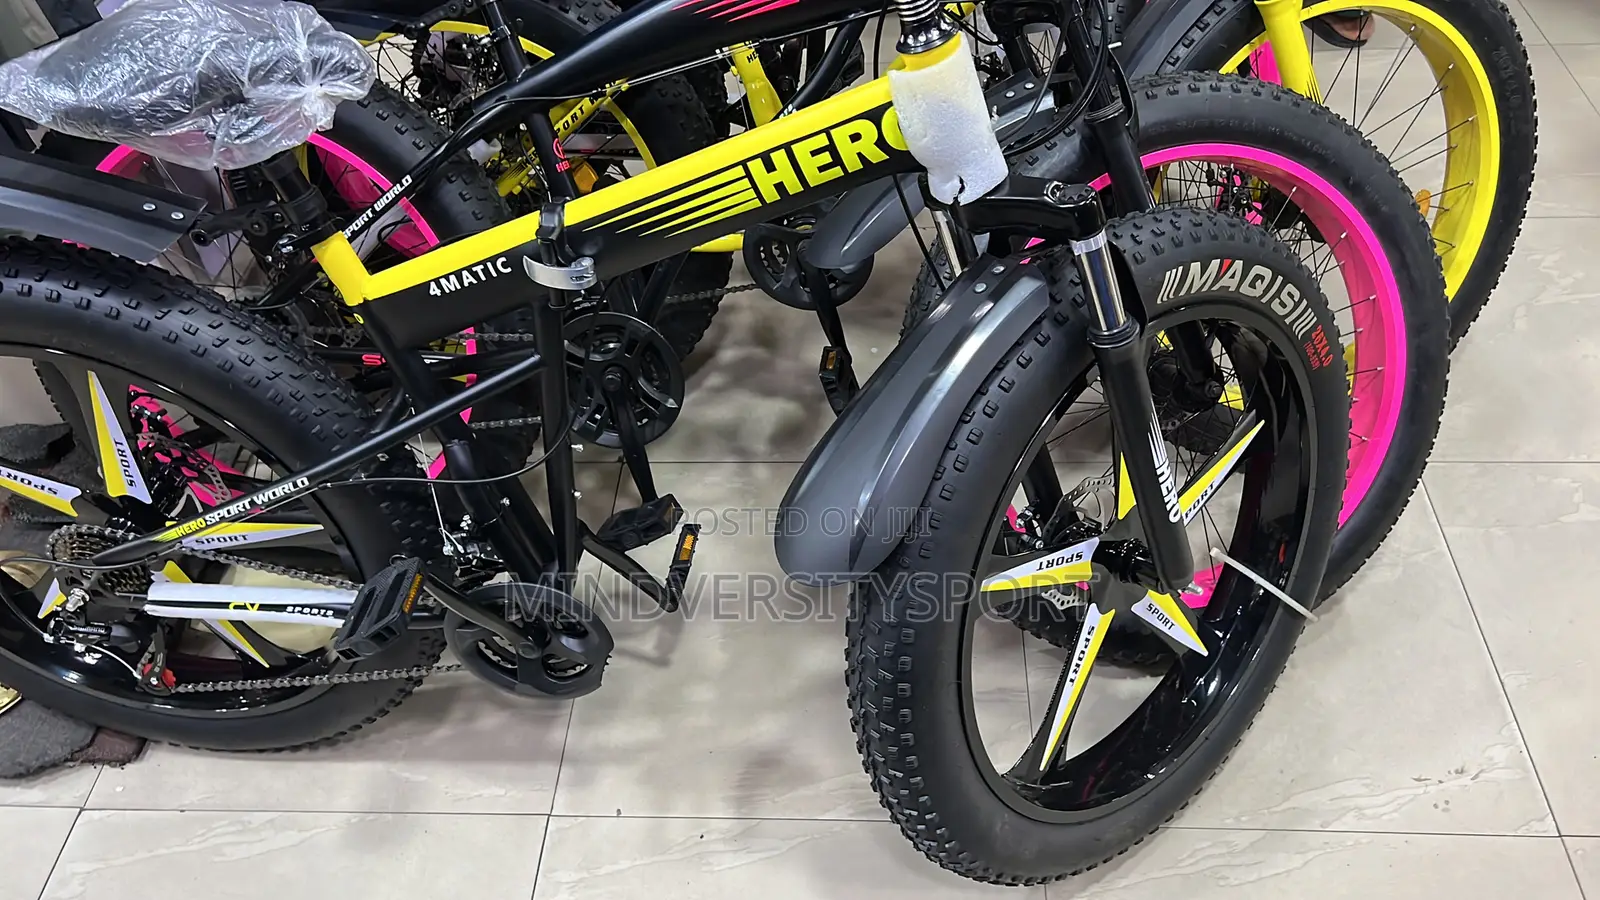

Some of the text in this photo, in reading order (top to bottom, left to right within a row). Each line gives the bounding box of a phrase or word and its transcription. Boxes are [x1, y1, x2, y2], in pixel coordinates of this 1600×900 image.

[373, 174, 413, 212] WORLD
[428, 256, 513, 297] 4MATIC
[0, 469, 59, 495] SPOR
[113, 439, 137, 488] SPORT
[176, 476, 310, 537] HERO SPORT WORLD
[1156, 457, 1181, 523] HERO
[1184, 483, 1215, 519] PORT
[195, 534, 249, 545] SPORT
[1035, 550, 1084, 571] SPORT
[1145, 602, 1176, 631] SPORT
[1068, 625, 1096, 687] SPORT
